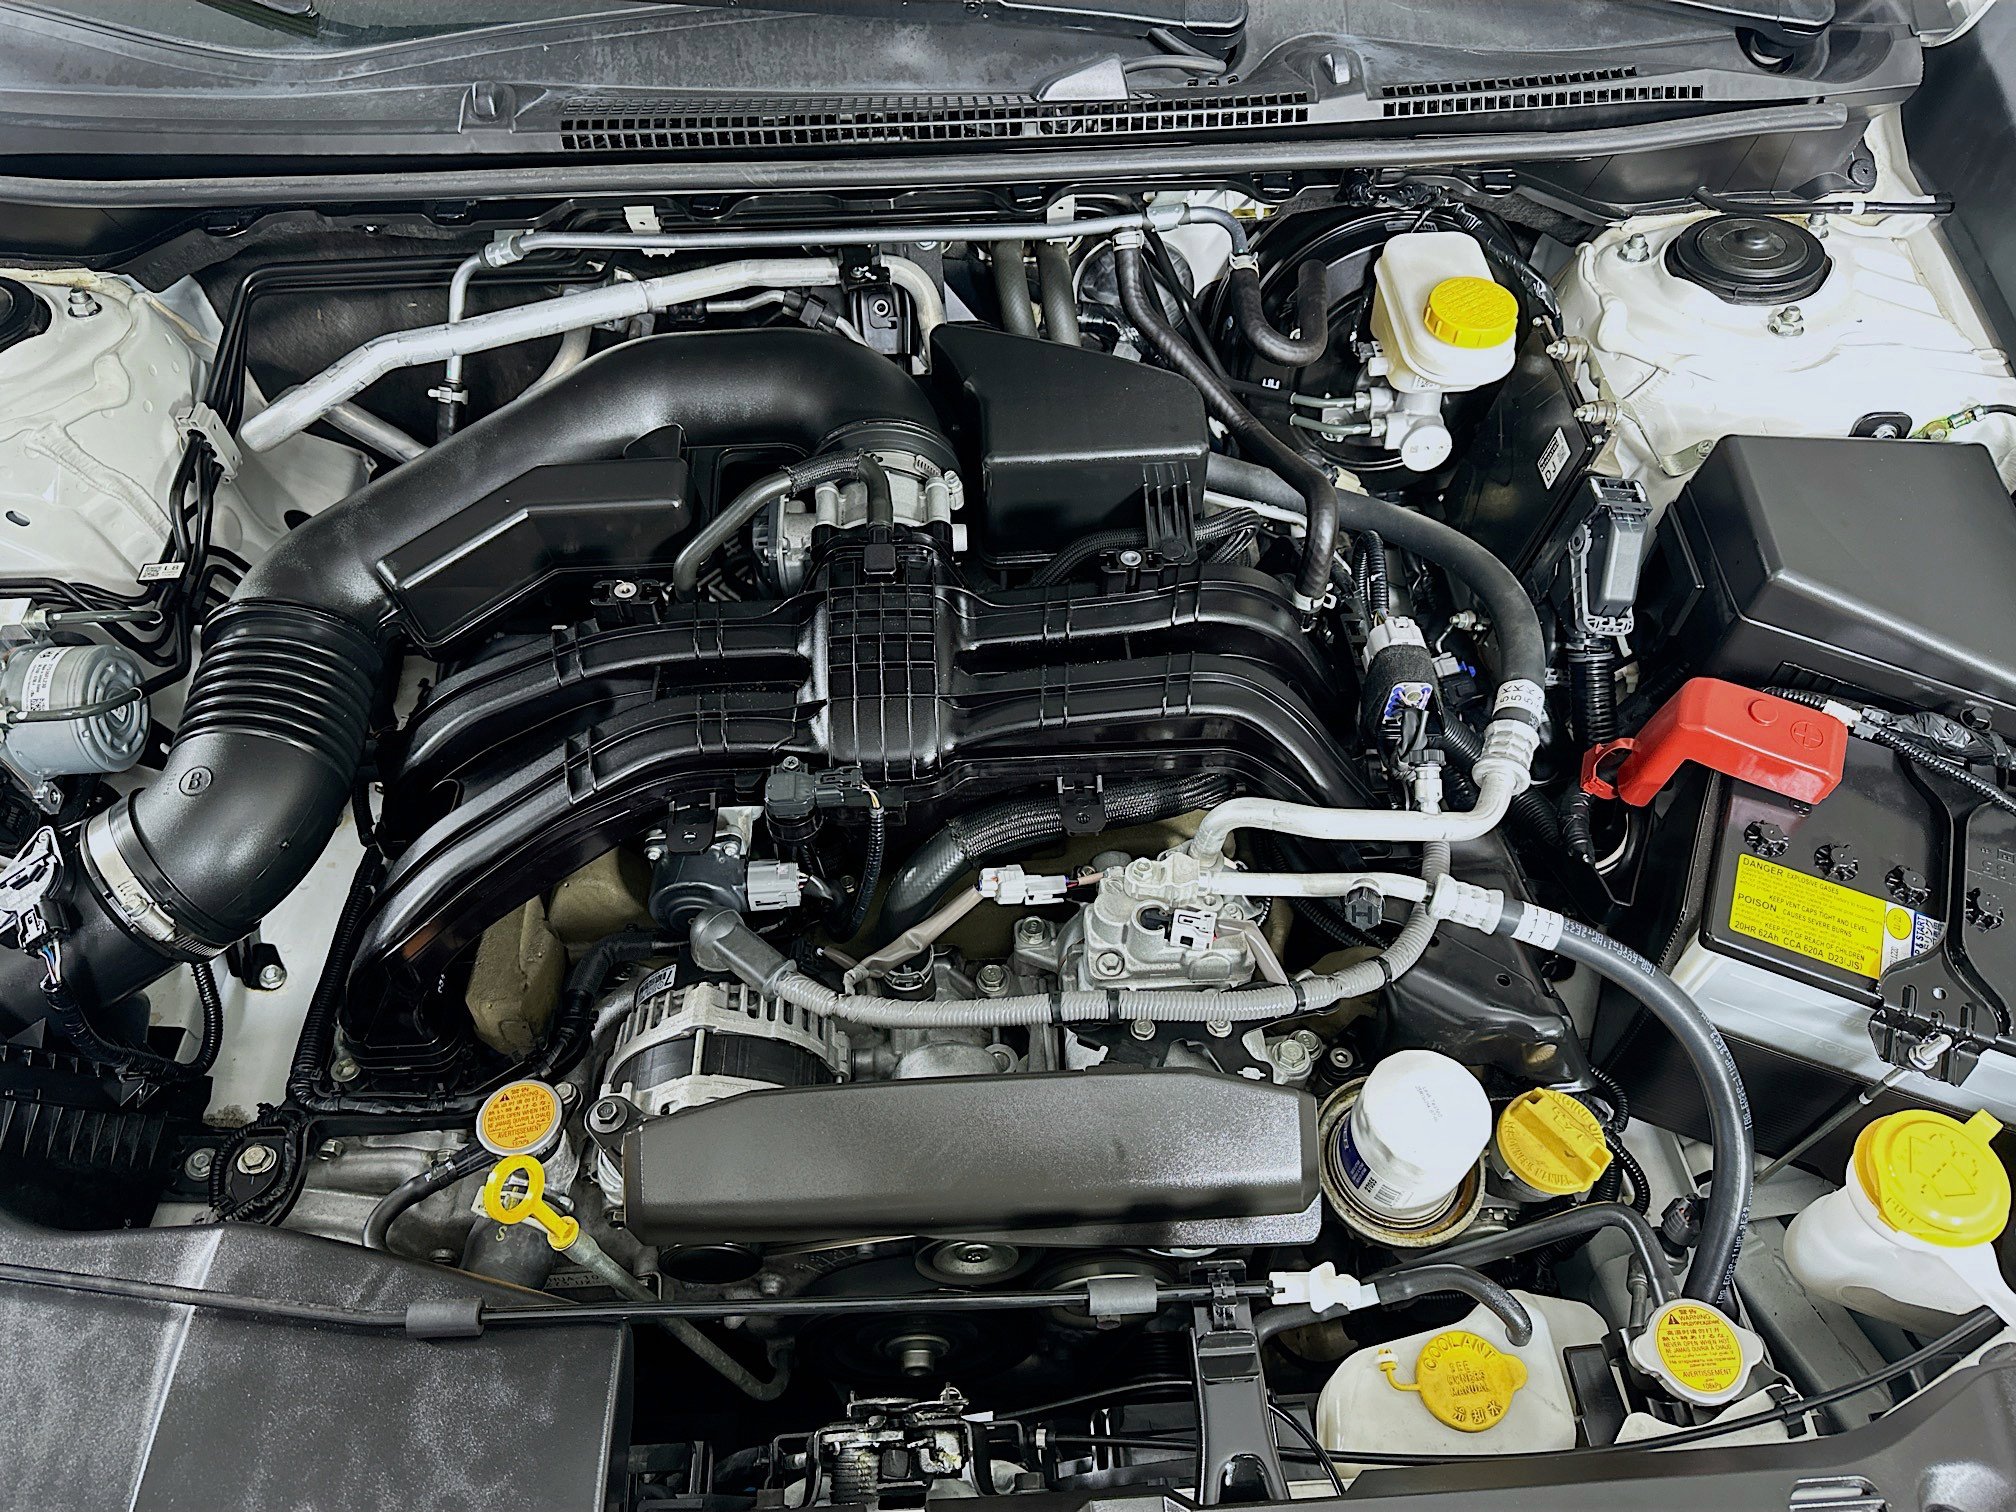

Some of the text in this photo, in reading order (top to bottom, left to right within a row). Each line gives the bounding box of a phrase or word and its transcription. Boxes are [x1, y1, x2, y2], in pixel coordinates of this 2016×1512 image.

[188, 771, 202, 790] B
[1743, 857, 1783, 876] DANGER
[1787, 872, 1817, 887] EXPLOSIVE
[1819, 883, 1838, 894] GASES
[1352, 905, 1373, 924] H
[1737, 892, 1776, 912] POISON
[1782, 908, 1806, 921] CAUSES
[1807, 916, 1830, 930] SEVERE
[1831, 925, 1852, 937] BURNS
[1769, 894, 1868, 933] KEEP VENT CAPS TIGHT AND LEVEL
[1734, 919, 1756, 934] 20HR
[1758, 927, 1778, 942] 62Ah
[1783, 936, 1801, 949] CCA
[1803, 943, 1824, 957] 620A
[1764, 921, 1864, 961] KEEP OUT OF REACH OF CHILDREN
[510, 1090, 538, 1099] WARNING
[487, 1114, 504, 1122] NEVER
[521, 1107, 538, 1115] WHEN
[497, 1124, 542, 1138] AVERTISSEMENT
[495, 1225, 508, 1242] S
[1423, 1335, 1496, 1370] COOLANT
[1448, 1360, 1470, 1373] SEE
[1682, 1369, 1732, 1378] AVERTISSEMENT
[1449, 1382, 1489, 1397] MANUAL
